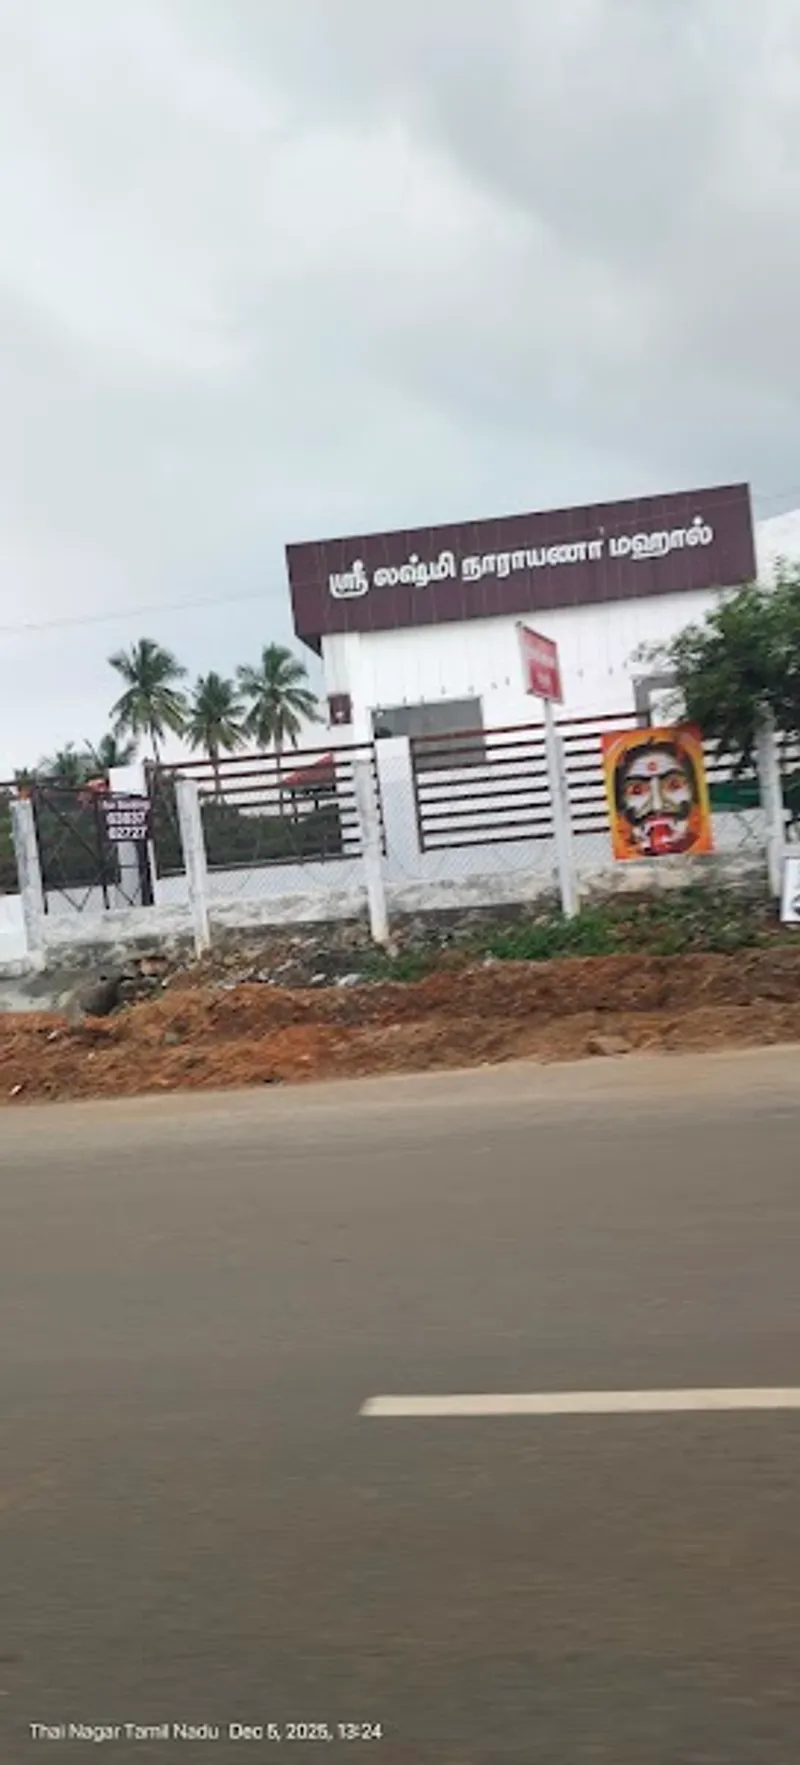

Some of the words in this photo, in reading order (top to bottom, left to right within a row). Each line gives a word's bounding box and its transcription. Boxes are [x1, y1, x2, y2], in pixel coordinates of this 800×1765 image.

[373, 550, 457, 588] லஷ்மி
[461, 539, 604, 581] நாராயணா
[609, 515, 713, 560] மஹால்
